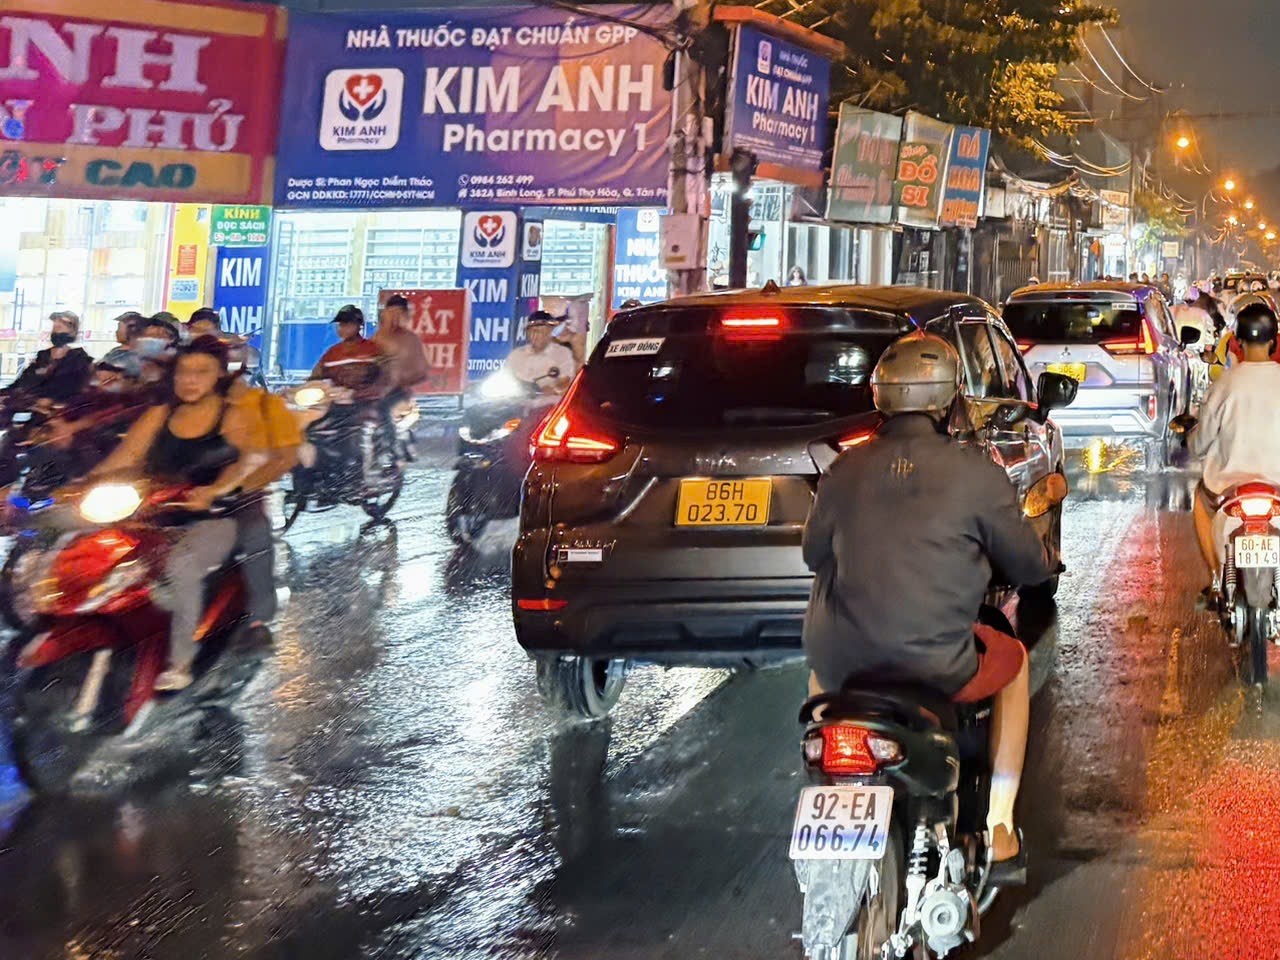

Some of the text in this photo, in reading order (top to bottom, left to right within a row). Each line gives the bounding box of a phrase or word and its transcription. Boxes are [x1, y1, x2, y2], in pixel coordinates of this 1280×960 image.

[346, 24, 391, 49] NHÀ
[397, 20, 467, 48] THUỐC
[471, 26, 510, 48] ĐẠT
[513, 16, 590, 46] CHUẨN
[422, 63, 655, 116] KIM ANH
[746, 73, 820, 123] KIM ANH
[66, 100, 245, 153] PHỦ
[332, 125, 387, 137] KIM ANH
[443, 123, 628, 156] Pharmacy
[752, 111, 809, 146] Pharmacy
[86, 158, 197, 189] CAO
[328, 177, 352, 187] Phan
[898, 154, 938, 184] ĐỒ
[901, 184, 930, 207] SI
[220, 257, 262, 288] KIM
[463, 278, 508, 304] KIM
[466, 358, 506, 373] armacy
[706, 481, 745, 501] 86H
[687, 504, 758, 523] 023.70
[811, 792, 877, 821] 92-EA
[797, 823, 880, 852] 066.74
